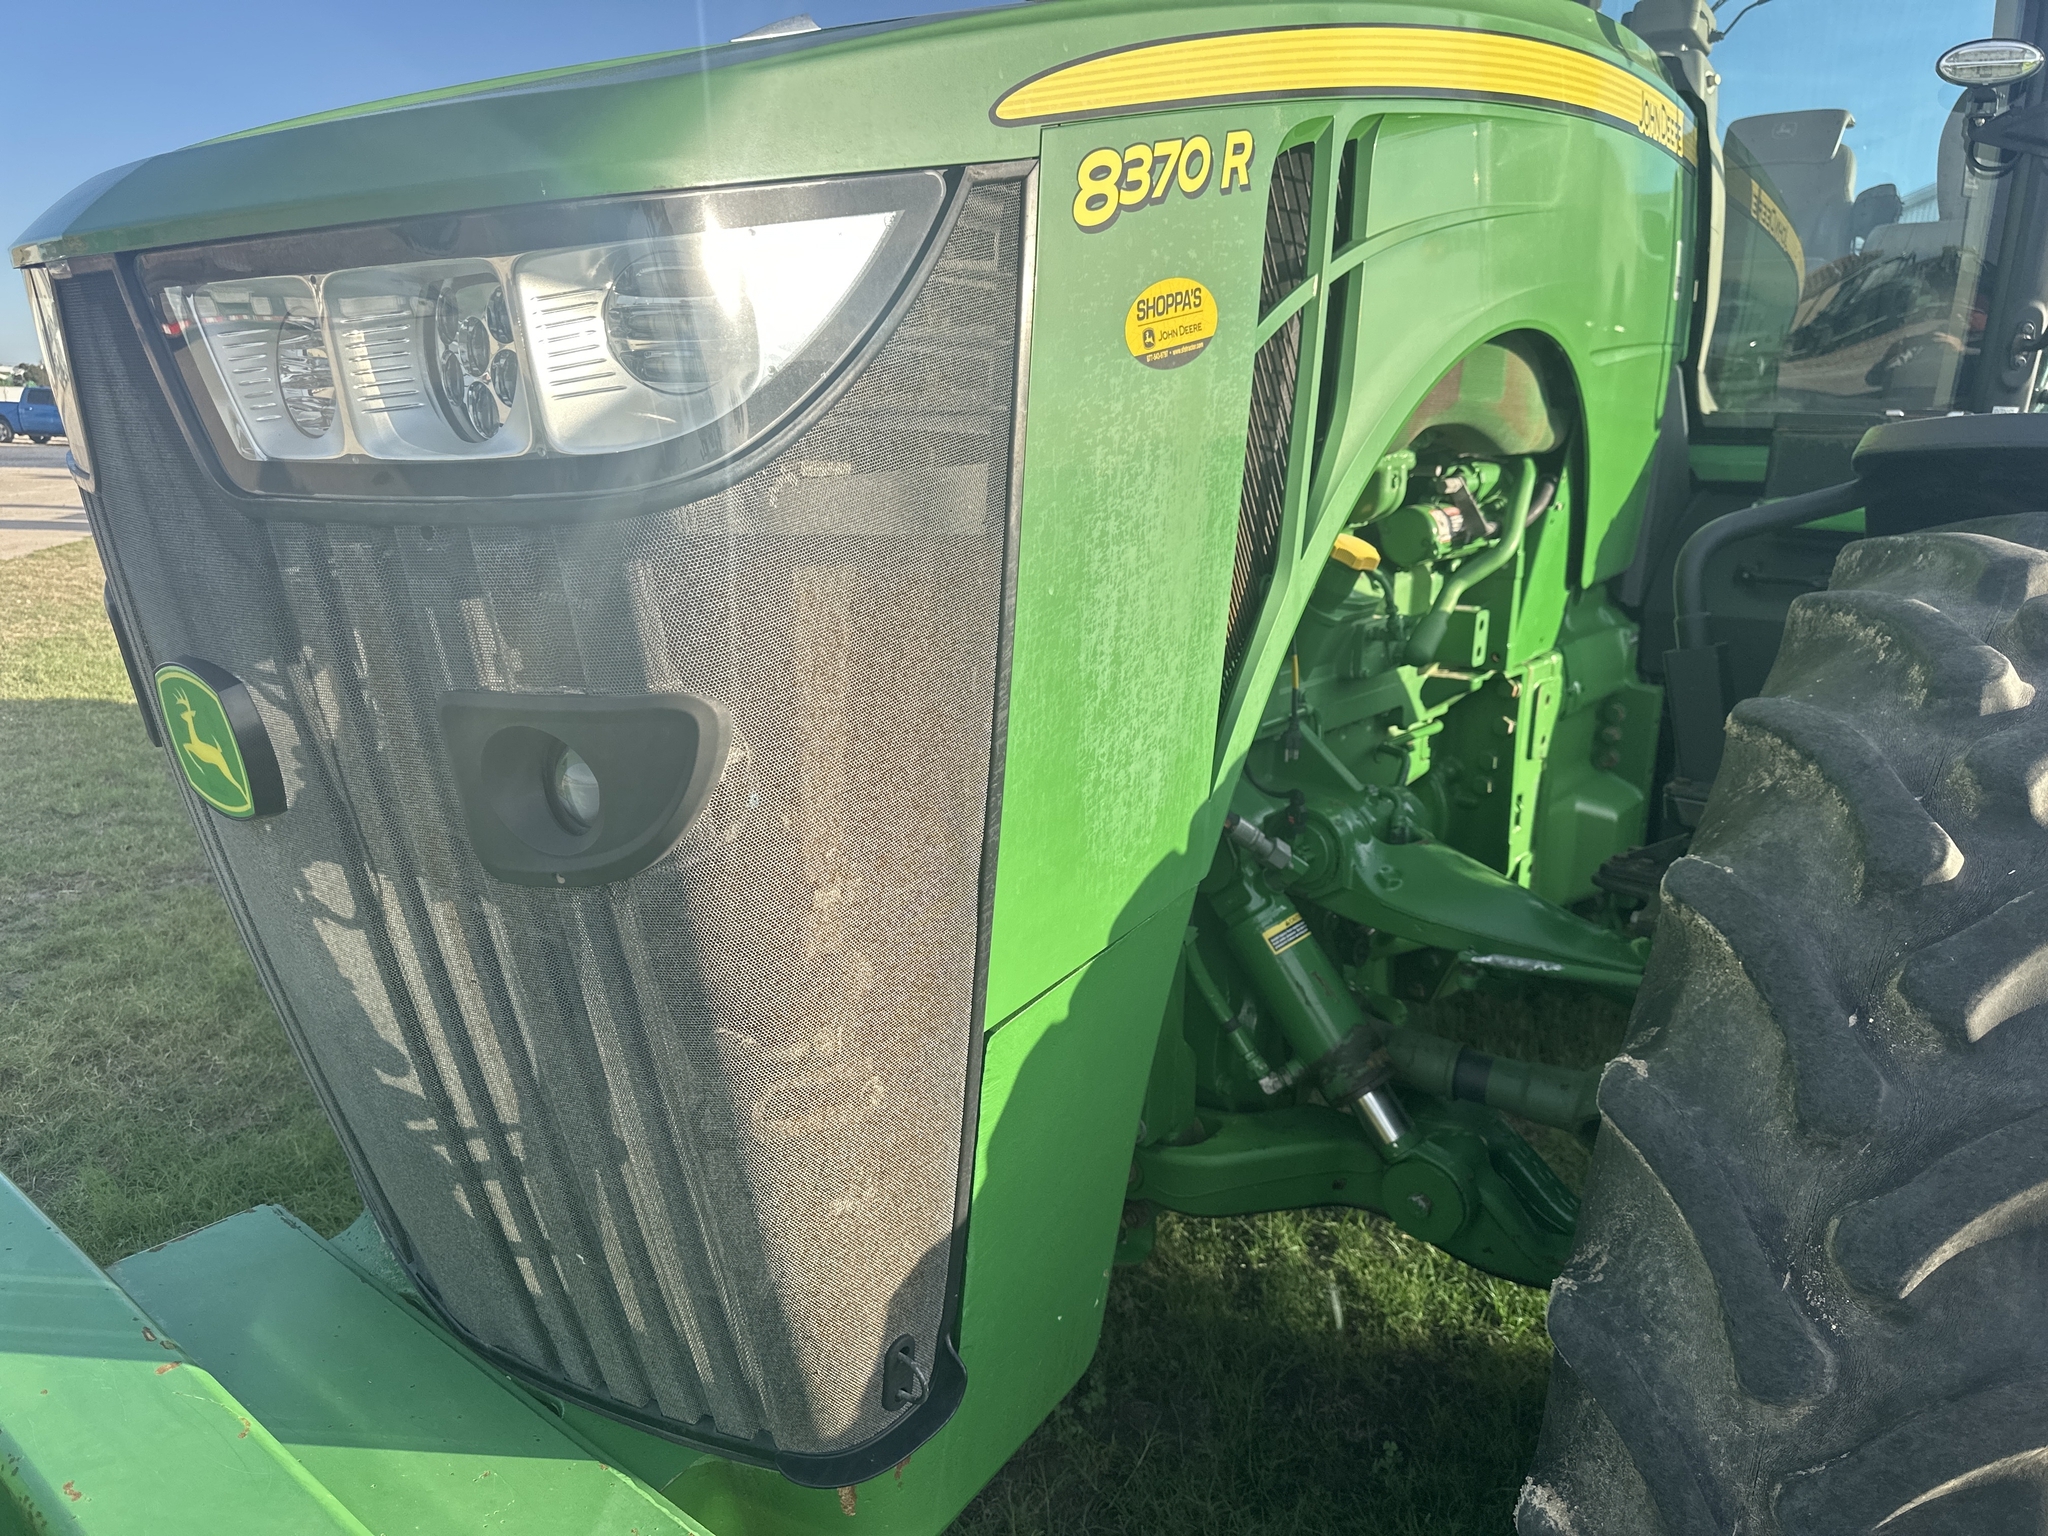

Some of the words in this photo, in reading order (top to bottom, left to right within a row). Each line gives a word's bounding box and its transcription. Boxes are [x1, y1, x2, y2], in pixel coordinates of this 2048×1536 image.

[1638, 91, 1660, 142] JOHN
[1661, 104, 1683, 152] DEERE
[1072, 135, 1213, 233] 8370
[1220, 129, 1256, 196] R
[1136, 287, 1202, 321] SHOPPA'S
[1158, 328, 1178, 342] JOHN
[1179, 322, 1203, 336] DEERE
